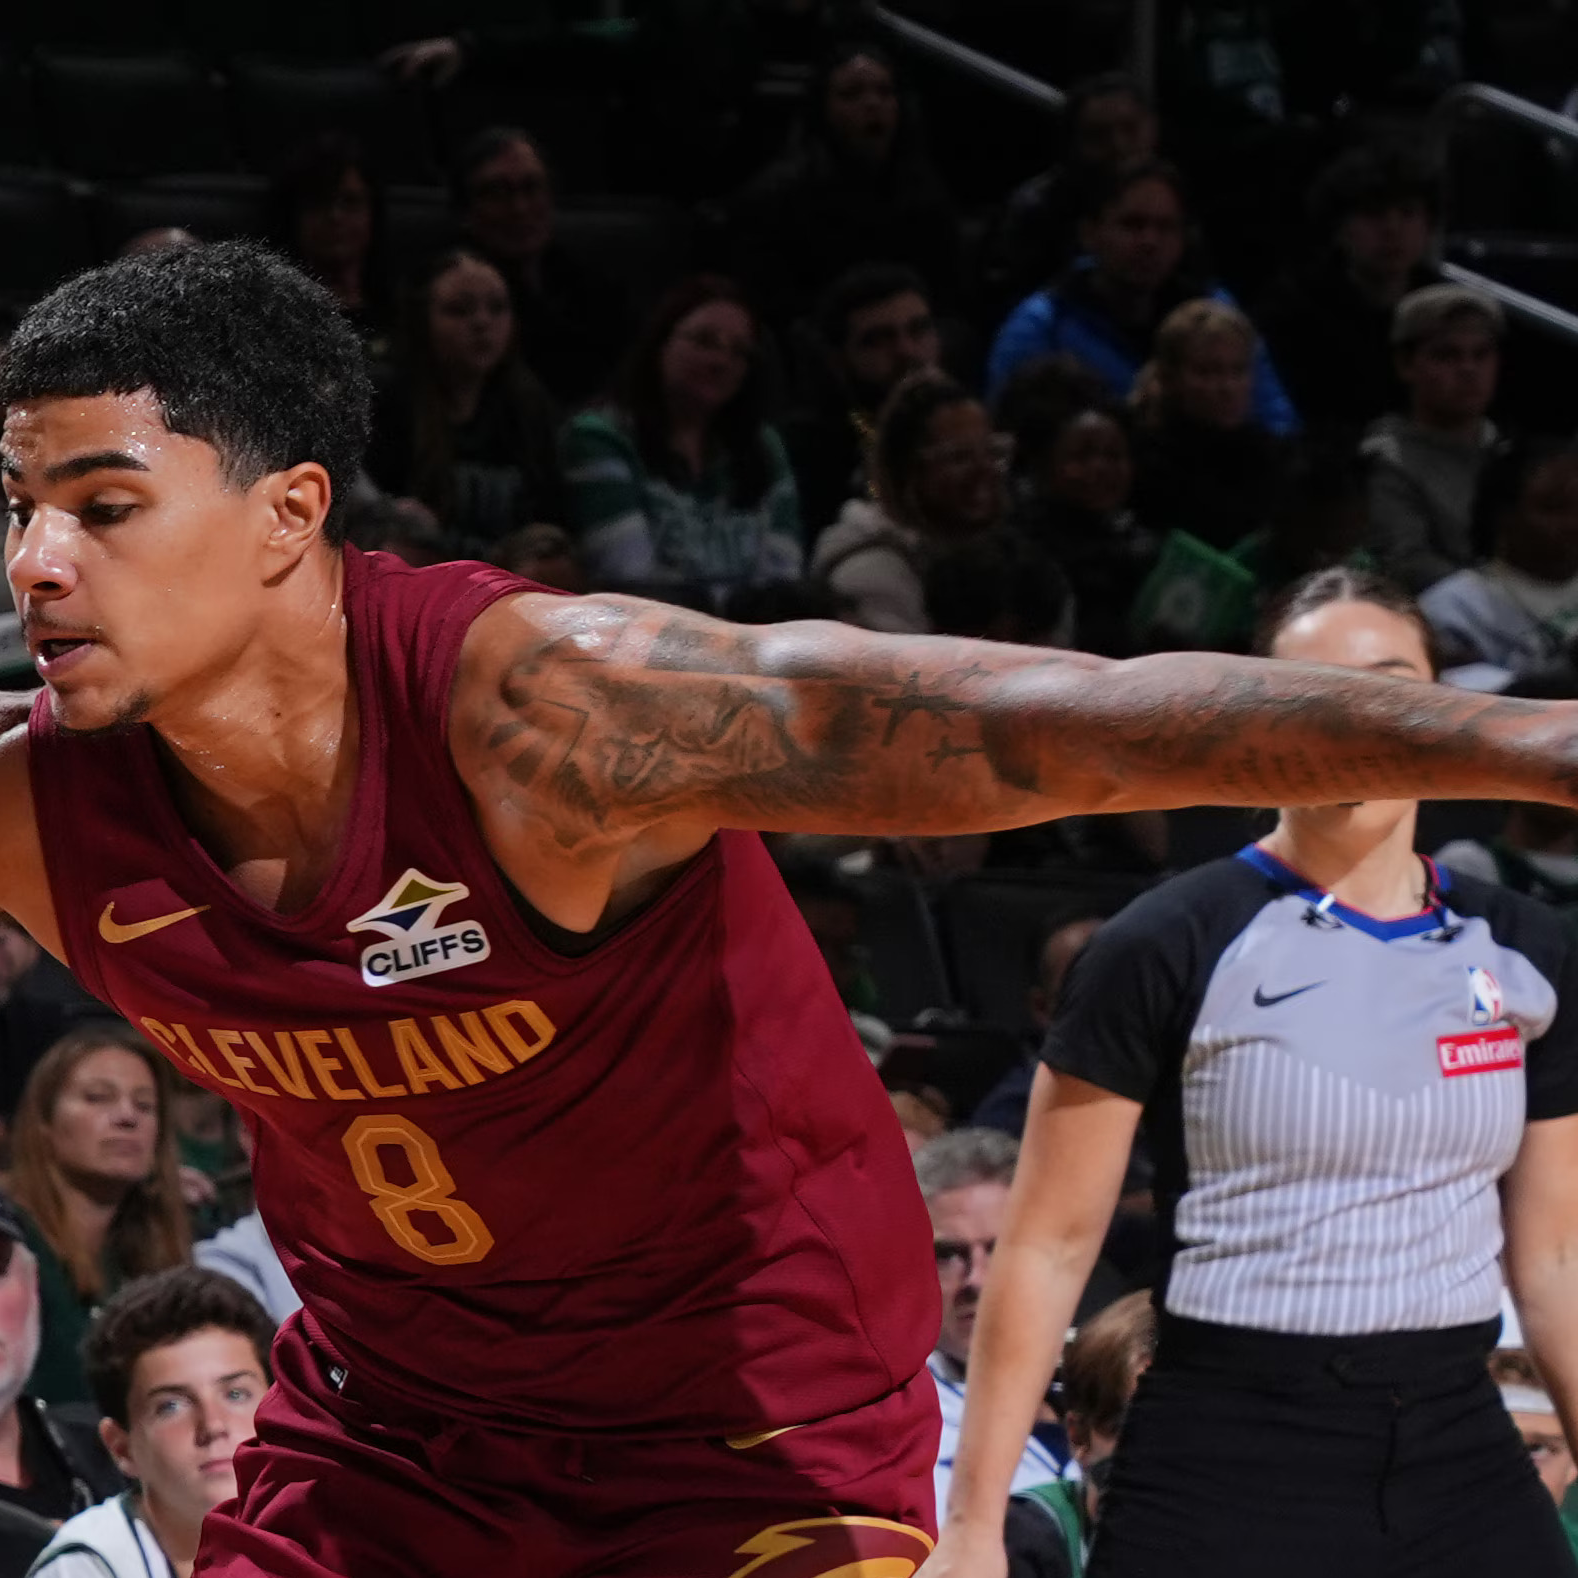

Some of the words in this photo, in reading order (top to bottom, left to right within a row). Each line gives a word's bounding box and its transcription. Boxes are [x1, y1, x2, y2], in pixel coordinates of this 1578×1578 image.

[366, 928, 485, 978] CLIFFS
[140, 999, 558, 1101] CLEVELAND
[341, 1113, 495, 1267] 8
